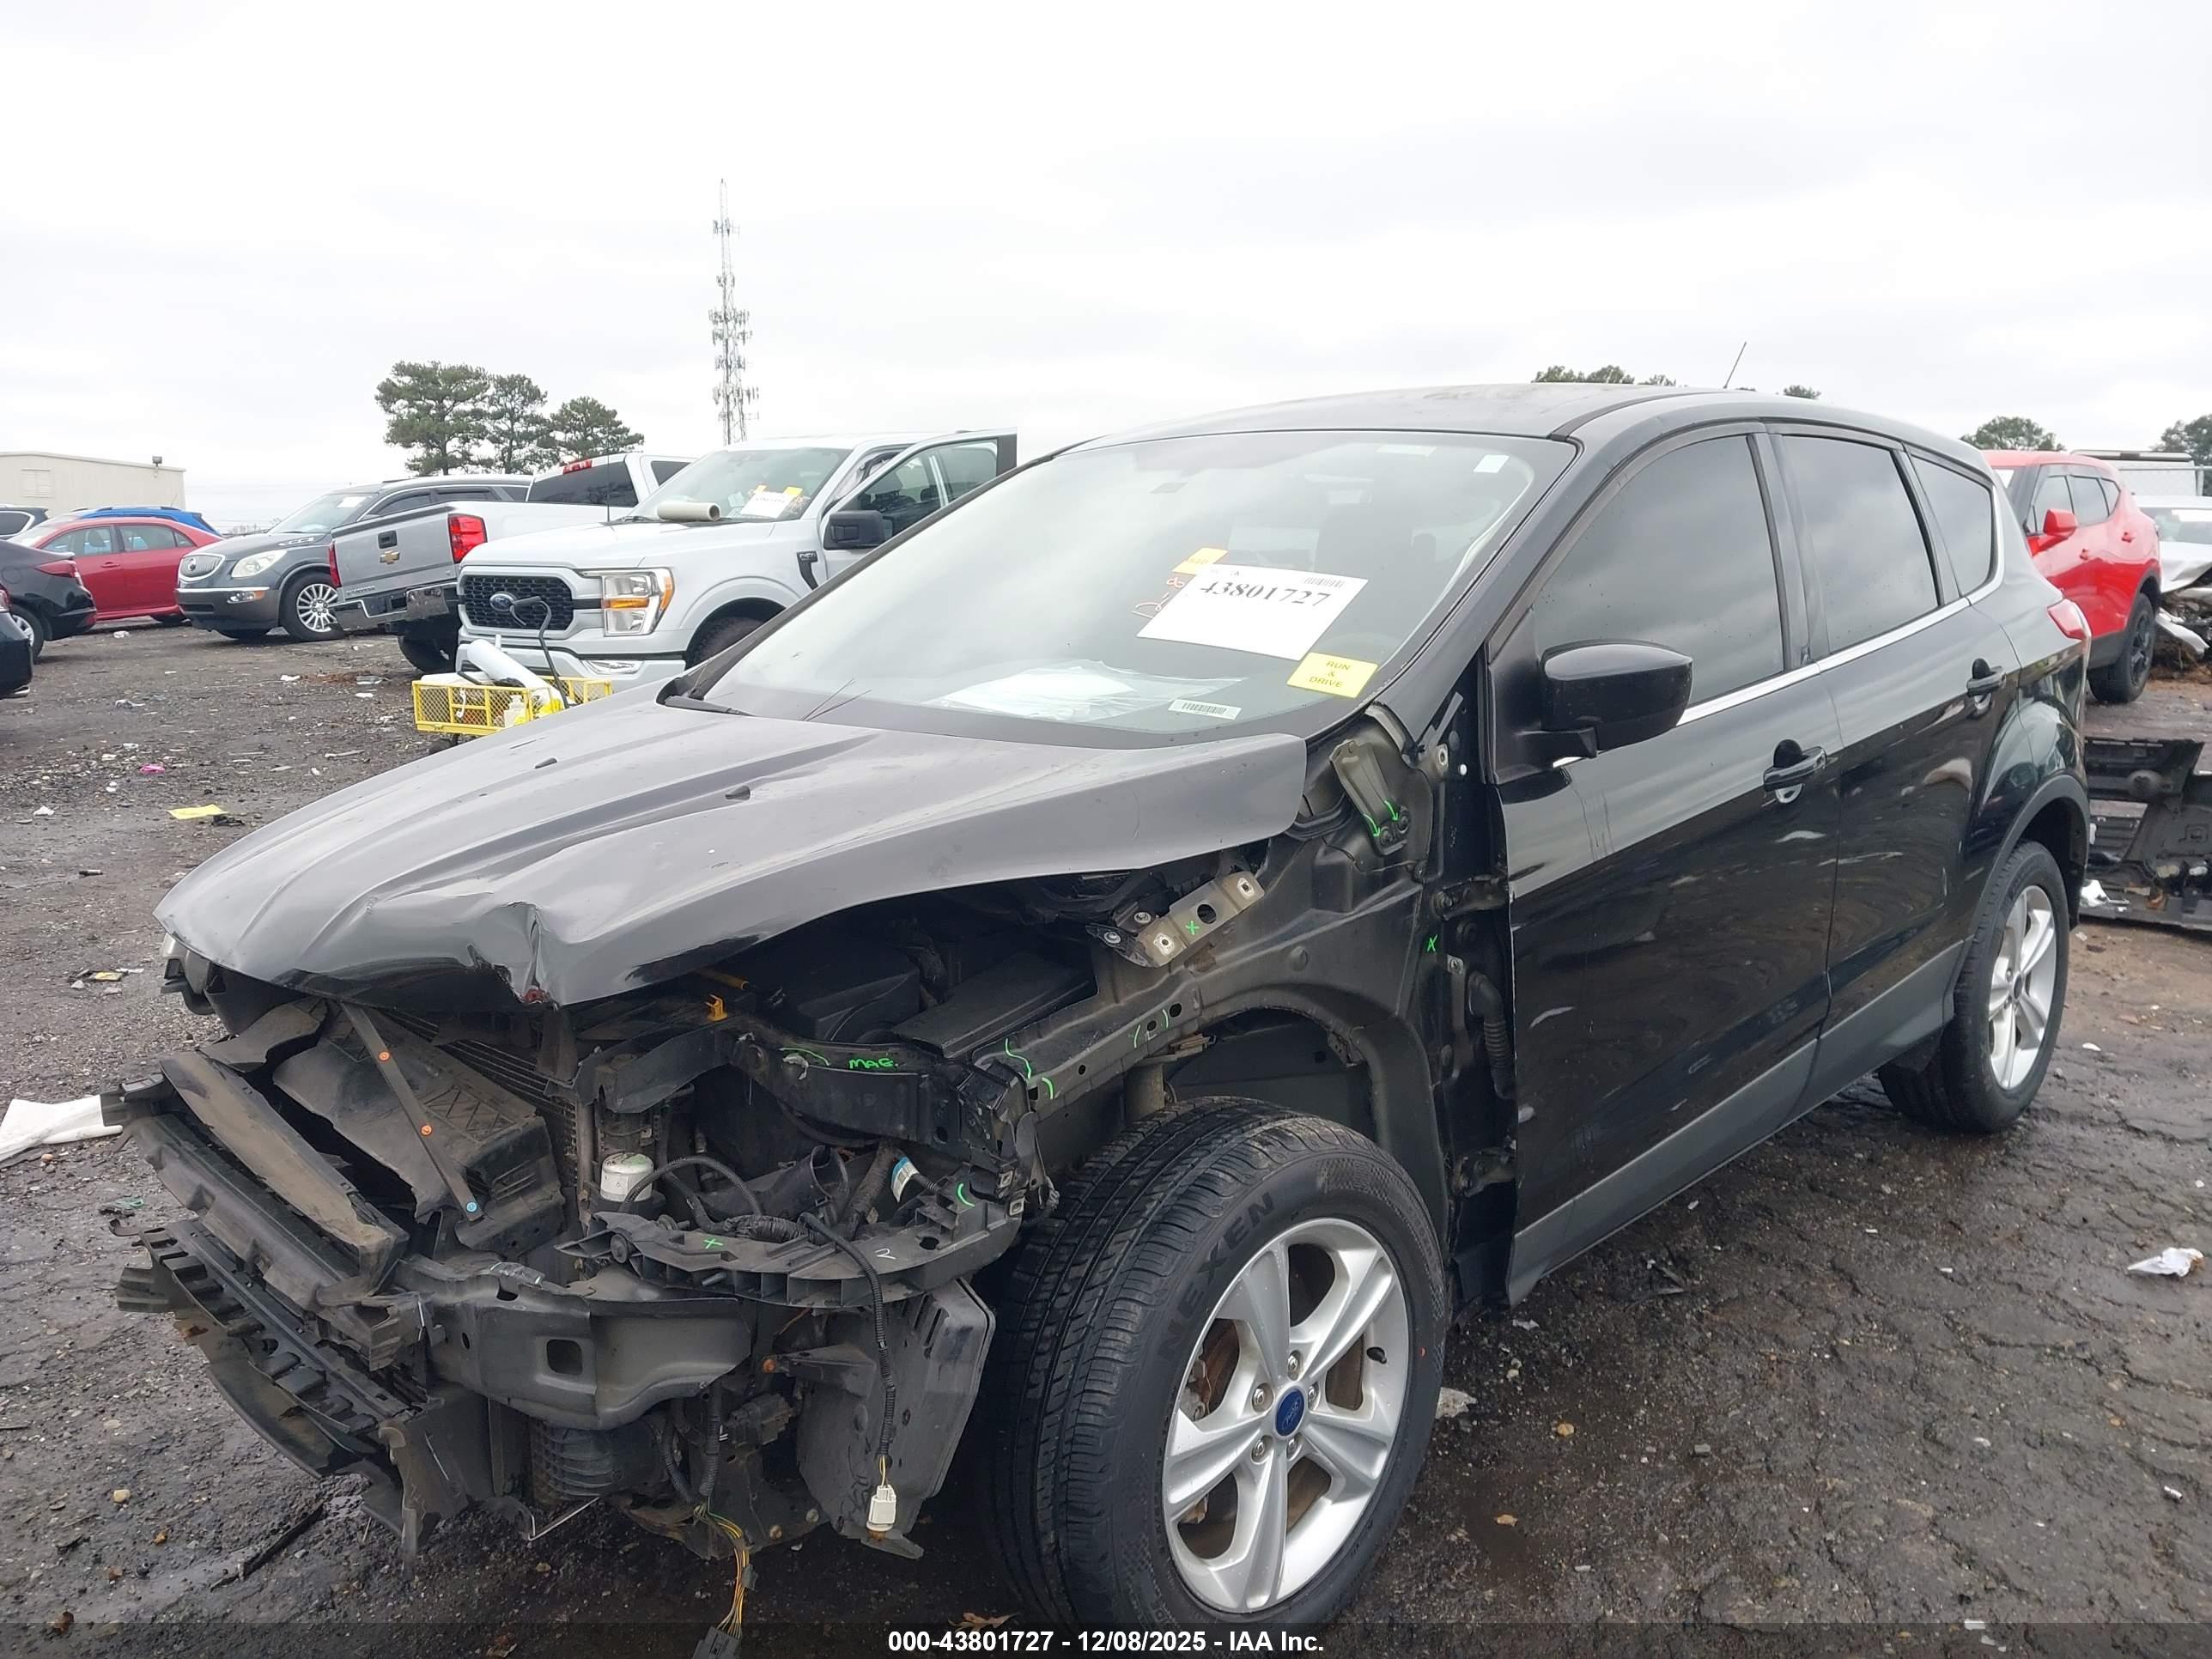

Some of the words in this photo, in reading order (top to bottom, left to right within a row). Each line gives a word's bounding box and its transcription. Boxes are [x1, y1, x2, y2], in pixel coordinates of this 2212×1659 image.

[1200, 580, 1332, 607] 43801727
[1326, 660, 1352, 671] RUN
[1309, 676, 1344, 688] DRIVE
[1158, 1191, 1275, 1362] NEXEN
